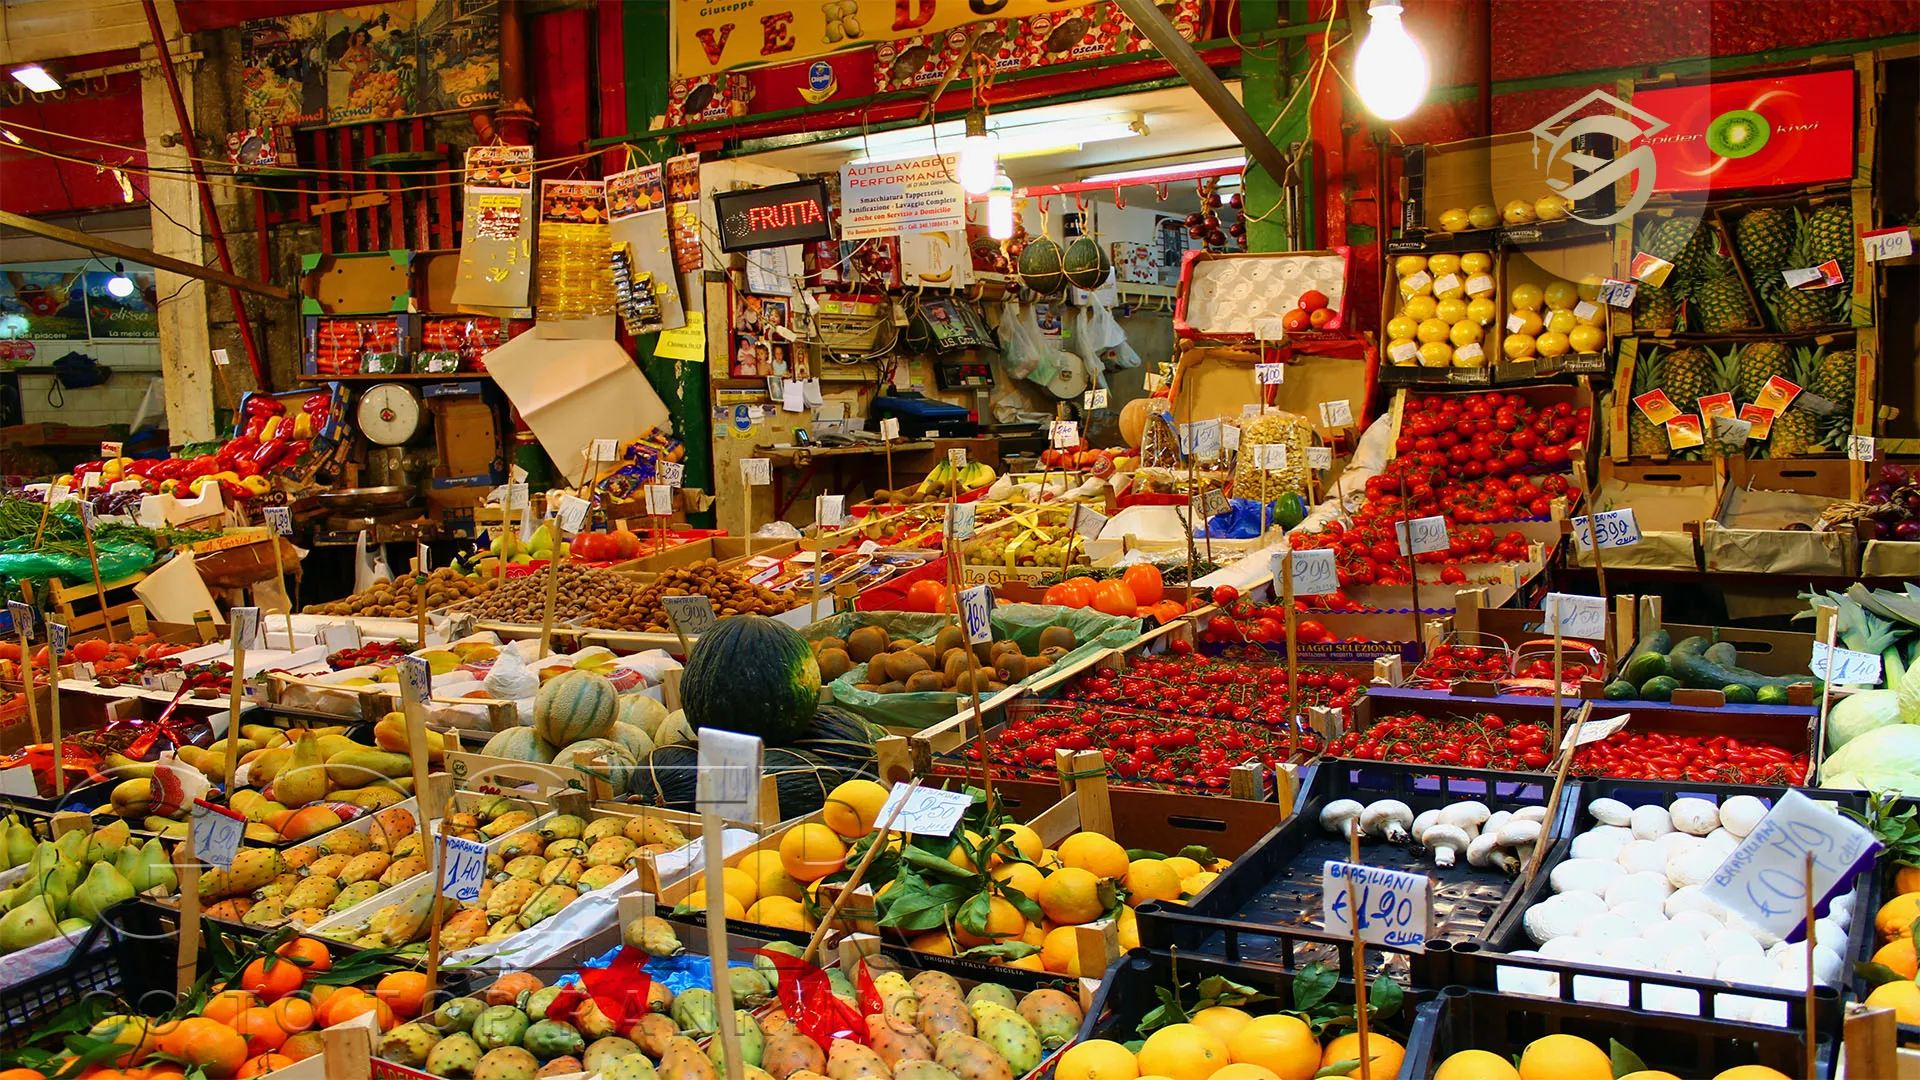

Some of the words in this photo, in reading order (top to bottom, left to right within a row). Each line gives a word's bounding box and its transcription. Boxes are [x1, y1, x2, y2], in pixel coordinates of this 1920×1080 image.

[700, 0, 755, 17] Giuseppe
[1072, 44, 1106, 55] OSCAR
[915, 71, 946, 81] OSCAR
[703, 108, 728, 117] OSCAR
[1640, 132, 1704, 146] spider
[1776, 120, 1819, 134] kiwi
[847, 156, 956, 177] AUTOLAVAGGIO
[860, 194, 904, 204] Smacchiatura
[905, 189, 944, 200] Tappezzeria
[848, 203, 890, 214] Sanificazione
[895, 200, 925, 210] Lavaggio
[749, 198, 824, 232] FRUTTA
[887, 210, 913, 219] Servizio
[1335, 643, 1404, 653] SELEZIONATI
[960, 961, 987, 971] ITALIA
[994, 966, 1025, 976] SICILIA
